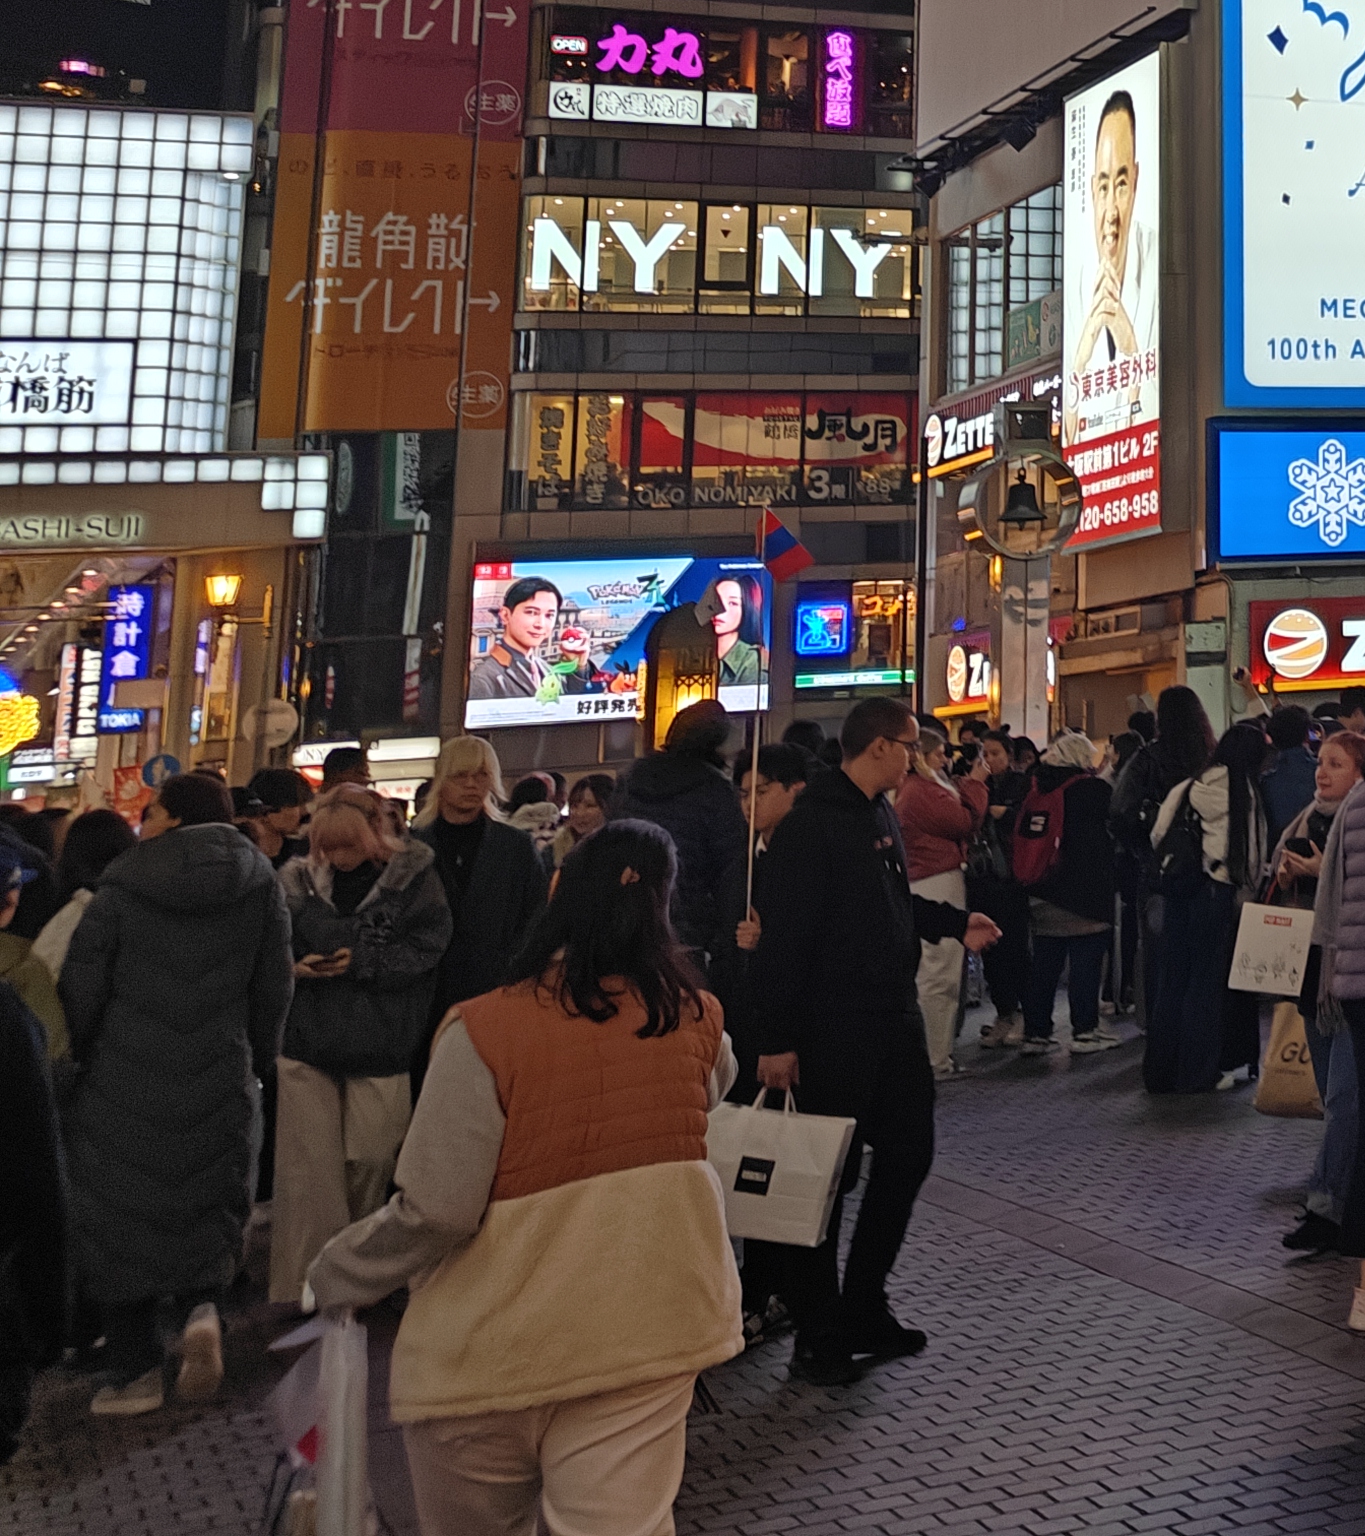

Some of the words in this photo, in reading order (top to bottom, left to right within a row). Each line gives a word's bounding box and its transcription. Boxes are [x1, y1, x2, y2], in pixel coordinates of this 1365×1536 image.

[552, 37, 586, 53] OPEN
[595, 24, 705, 78] 力丸
[825, 32, 852, 126] 食べ放題
[319, 209, 476, 271] 龍角散
[284, 278, 464, 335] ダイレクト
[1081, 348, 1157, 402] 東京美容外科
[1267, 338, 1337, 361] 100th
[805, 407, 897, 454] 風月
[1143, 430, 1159, 457] 2F
